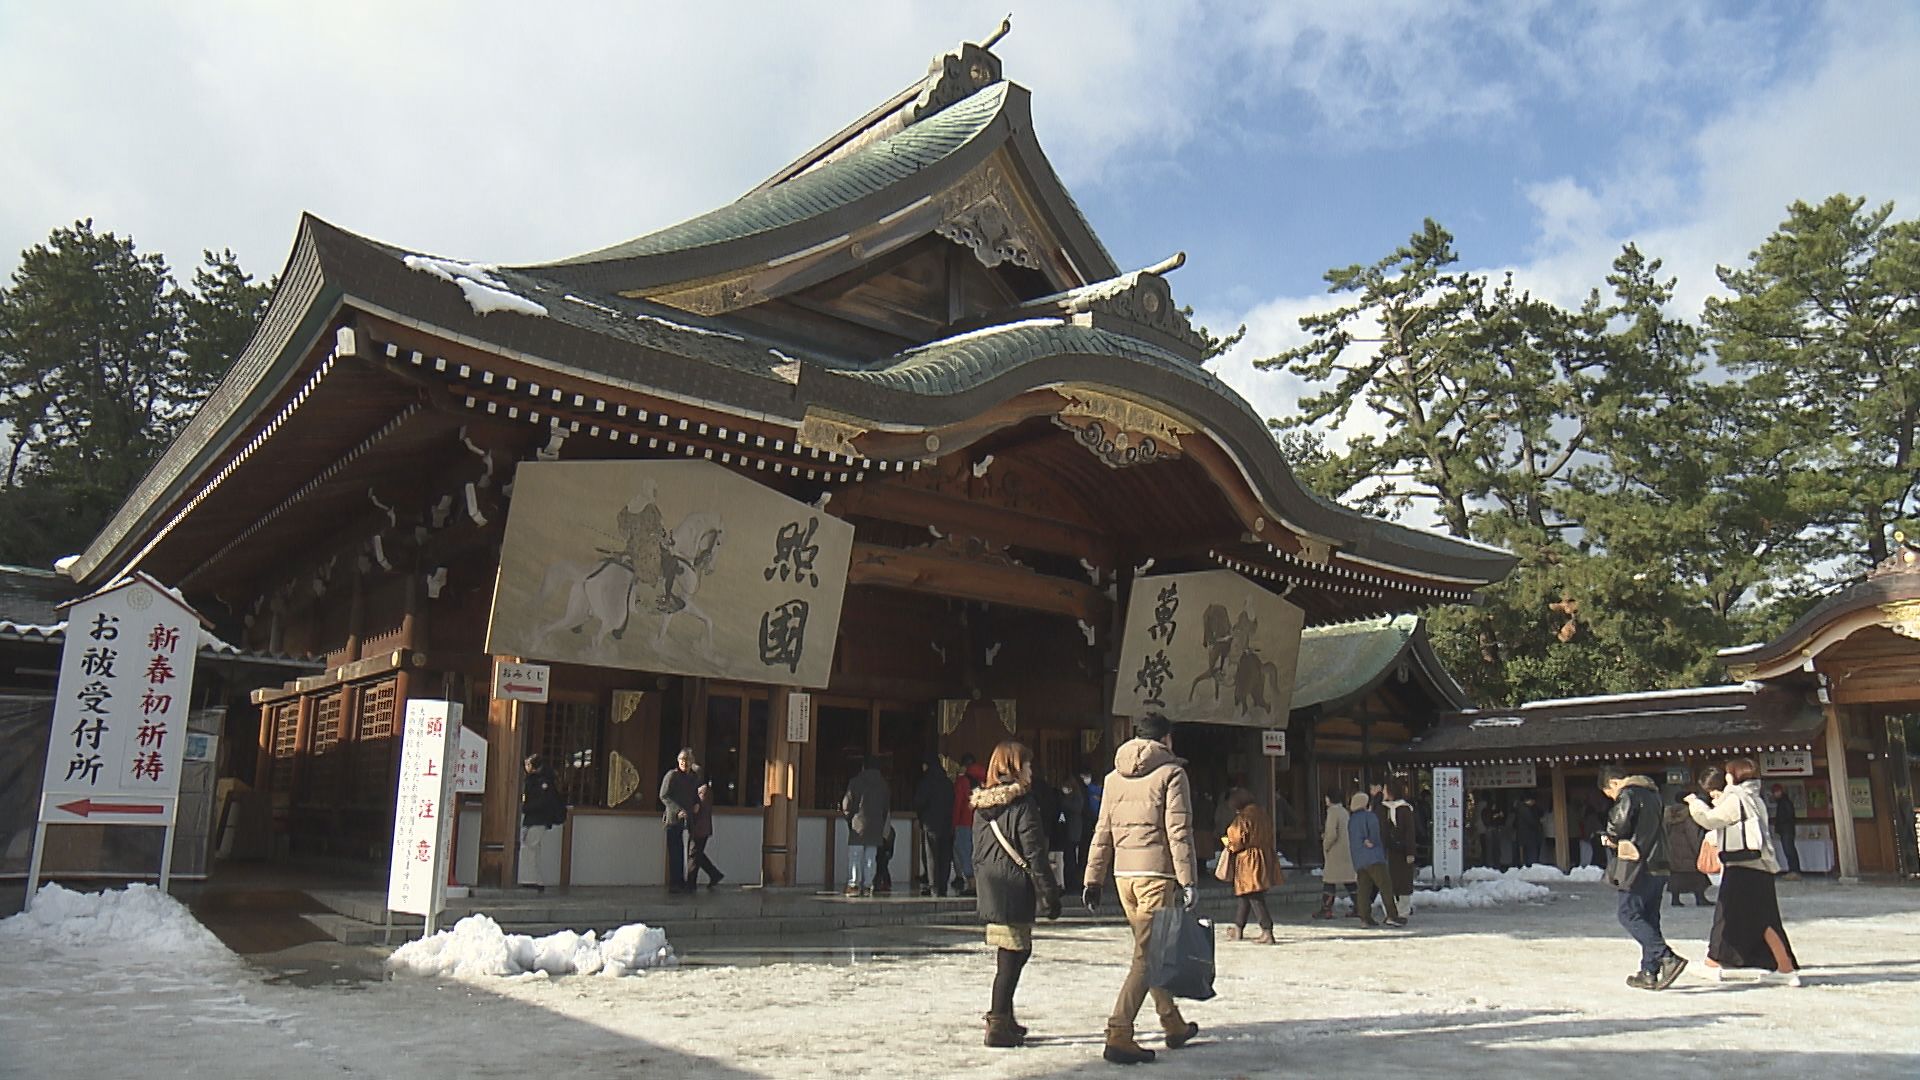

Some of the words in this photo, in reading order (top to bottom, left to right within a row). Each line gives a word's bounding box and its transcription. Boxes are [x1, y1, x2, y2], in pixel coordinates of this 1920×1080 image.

[64, 613, 120, 786] お祓受付所
[503, 667, 544, 681] おみくじ
[414, 716, 443, 862] 頭上注意
